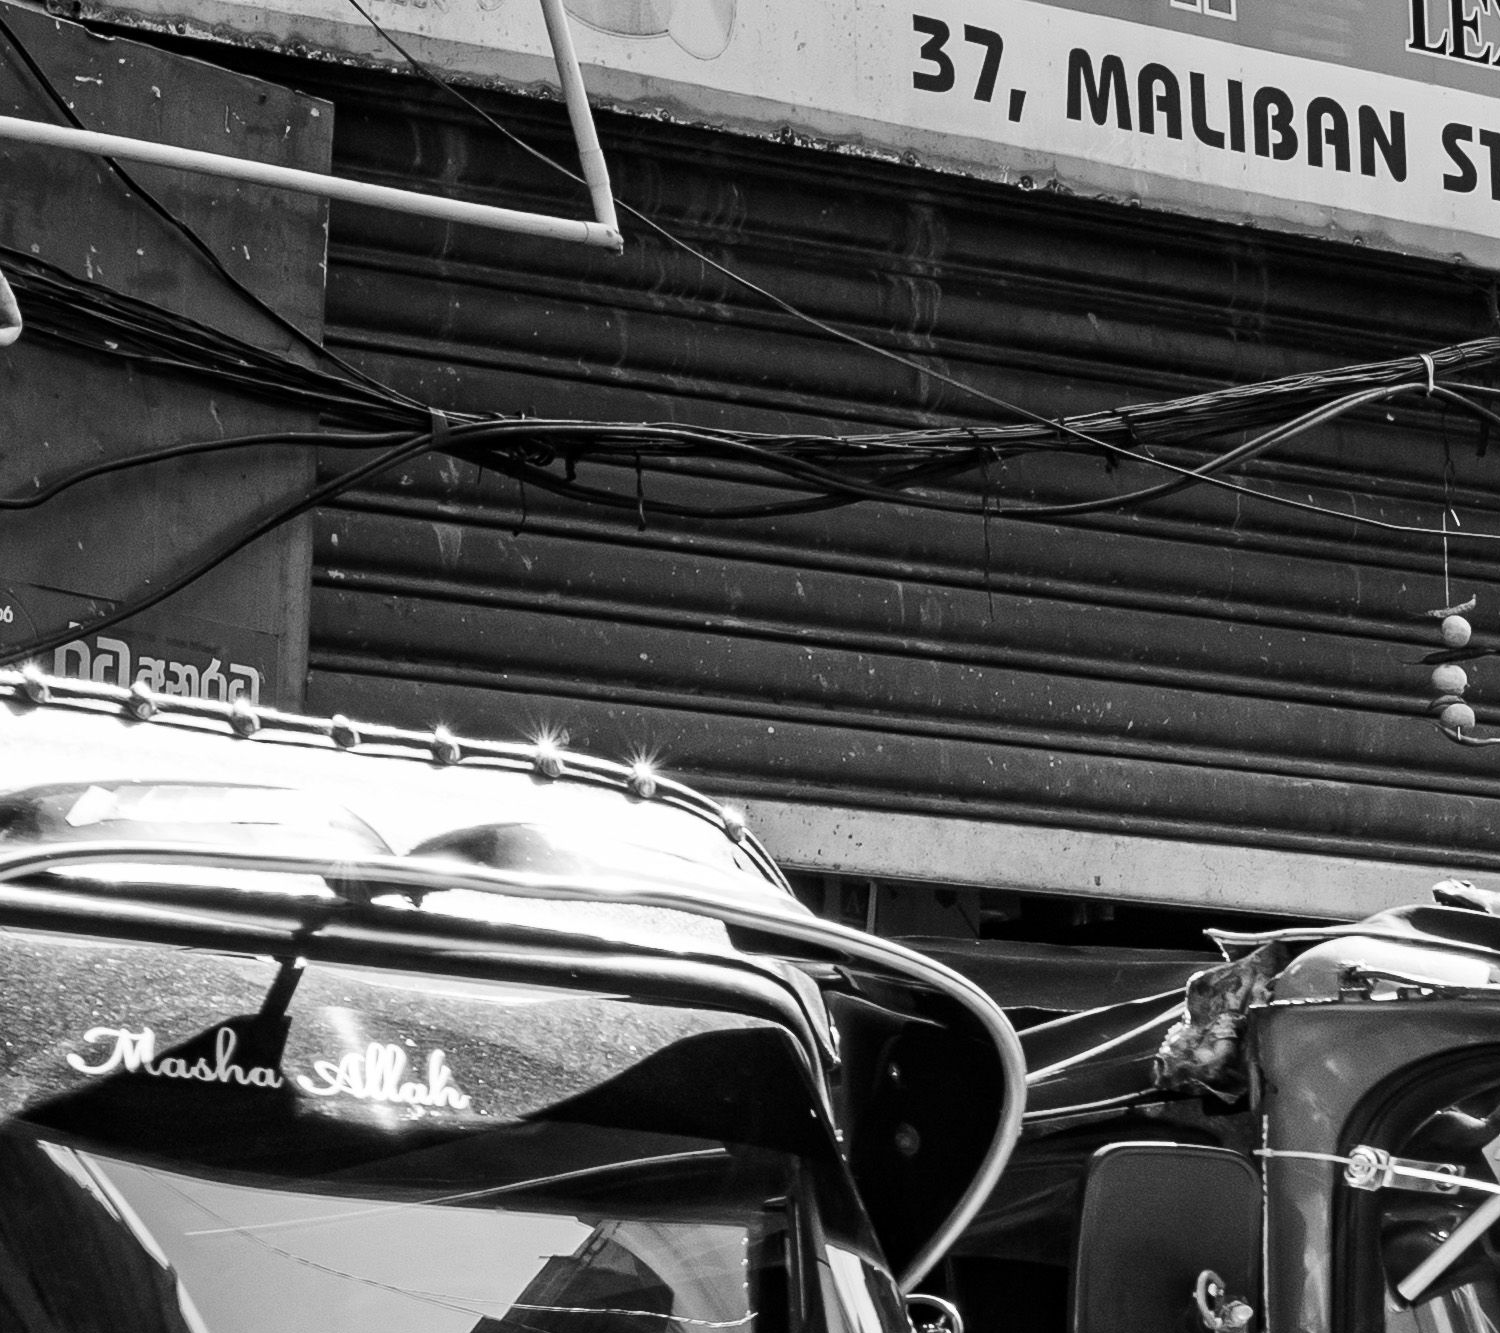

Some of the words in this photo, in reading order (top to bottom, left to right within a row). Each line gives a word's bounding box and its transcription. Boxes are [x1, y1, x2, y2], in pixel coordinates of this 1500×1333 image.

[913, 13, 1030, 123] 37,
[1067, 46, 1407, 183] MALIBAN
[66, 1025, 285, 1089] Masha
[298, 1041, 472, 1110] Allah
